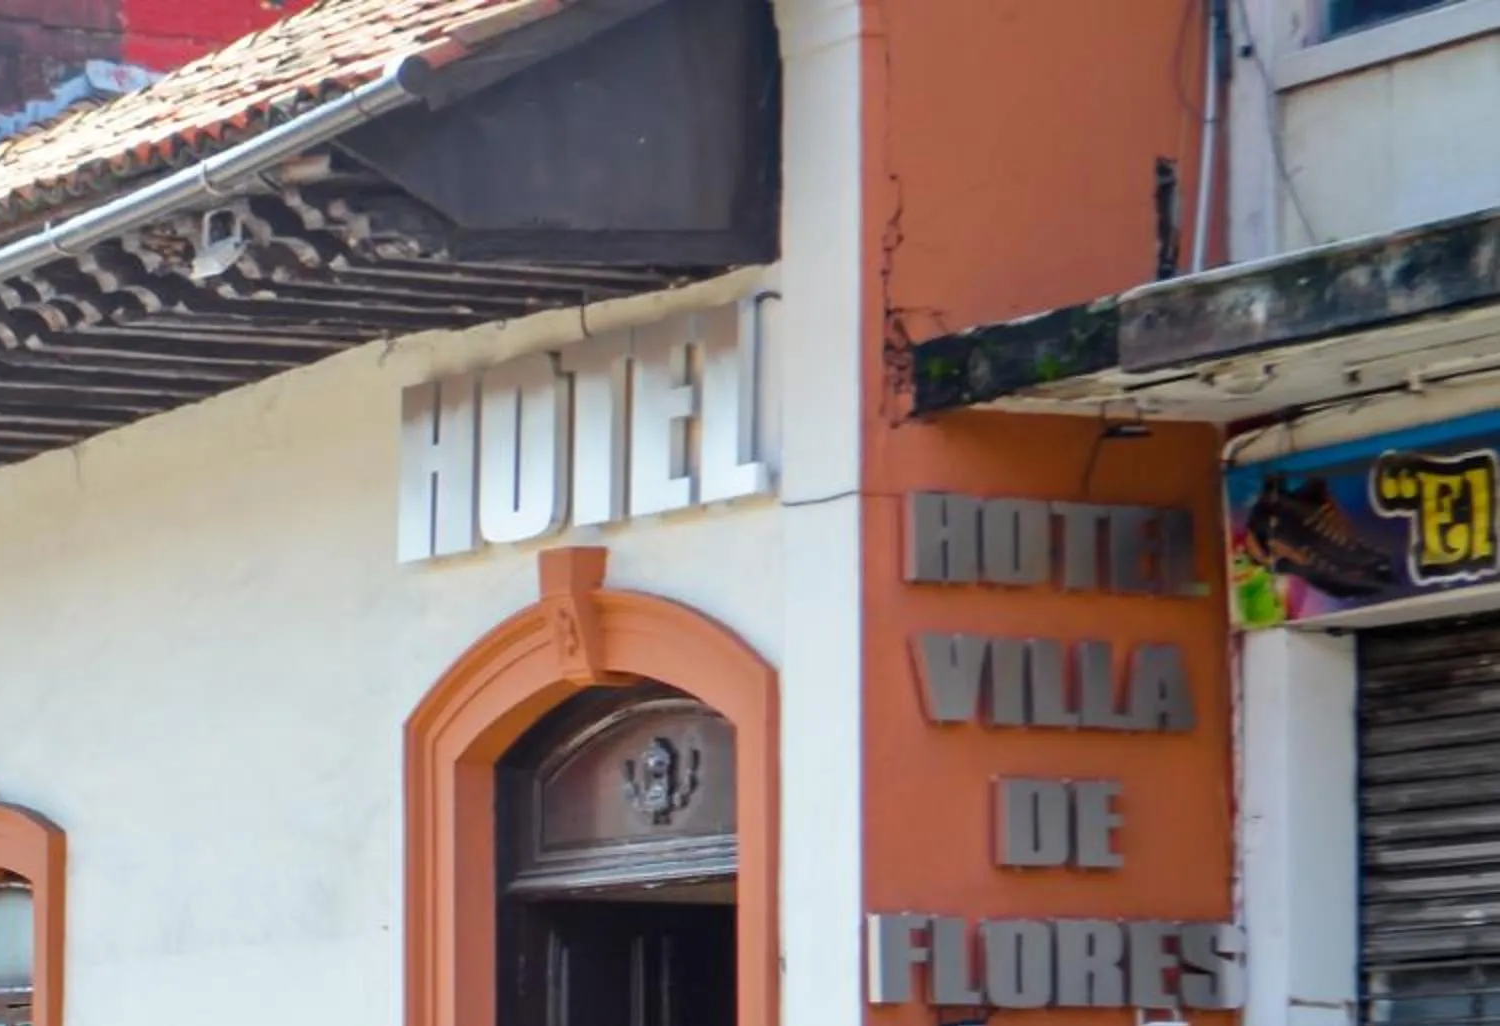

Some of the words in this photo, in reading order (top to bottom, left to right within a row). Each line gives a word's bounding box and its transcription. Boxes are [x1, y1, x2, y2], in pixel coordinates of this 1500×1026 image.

[397, 303, 766, 564] HOTEL
[902, 491, 1210, 597] HOTEL
[912, 632, 1197, 733] VILLA
[993, 777, 1126, 869] DE
[867, 912, 1248, 1010] FLORES
